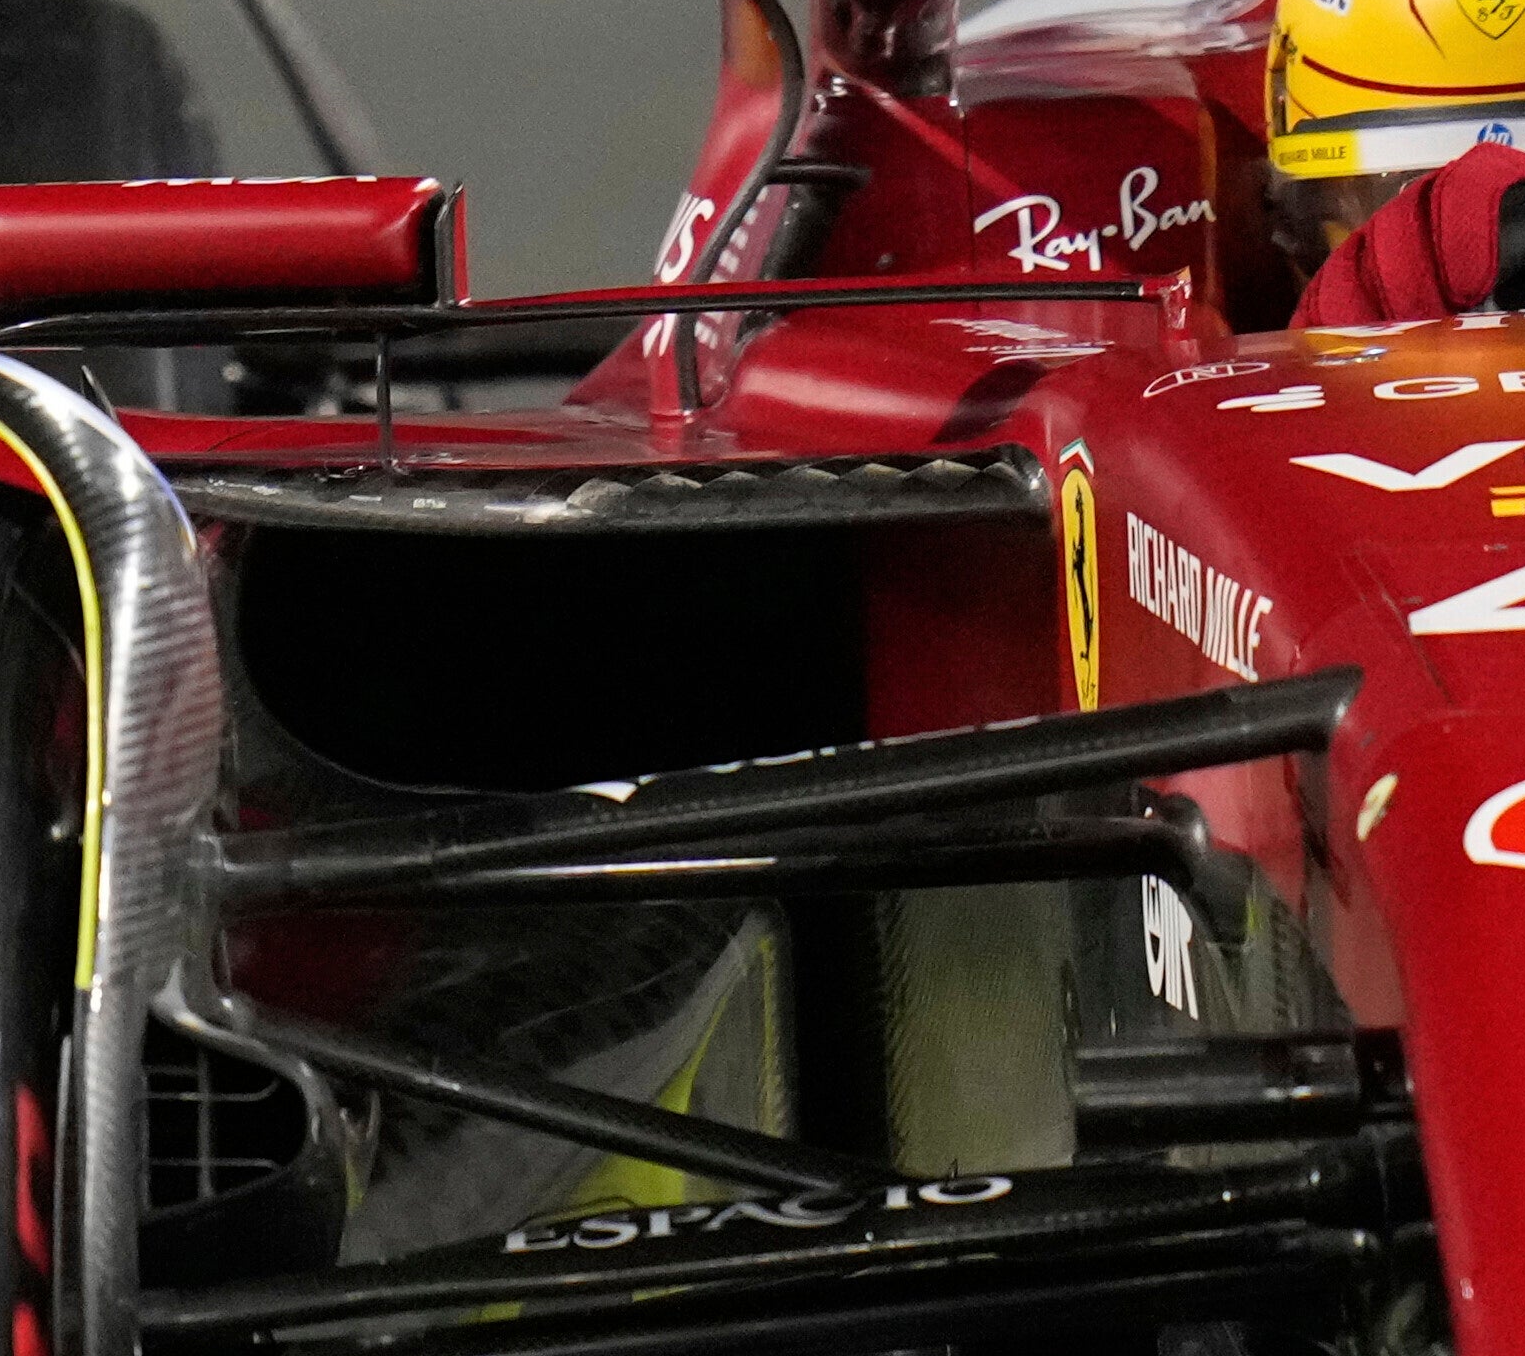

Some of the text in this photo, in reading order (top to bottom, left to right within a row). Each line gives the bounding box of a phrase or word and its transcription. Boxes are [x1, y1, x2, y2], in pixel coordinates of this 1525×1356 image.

[973, 166, 1217, 274] Ray-Ban
[1127, 512, 1273, 683] RICHARD MILLE
[503, 1175, 1013, 1252] ESPACIO
